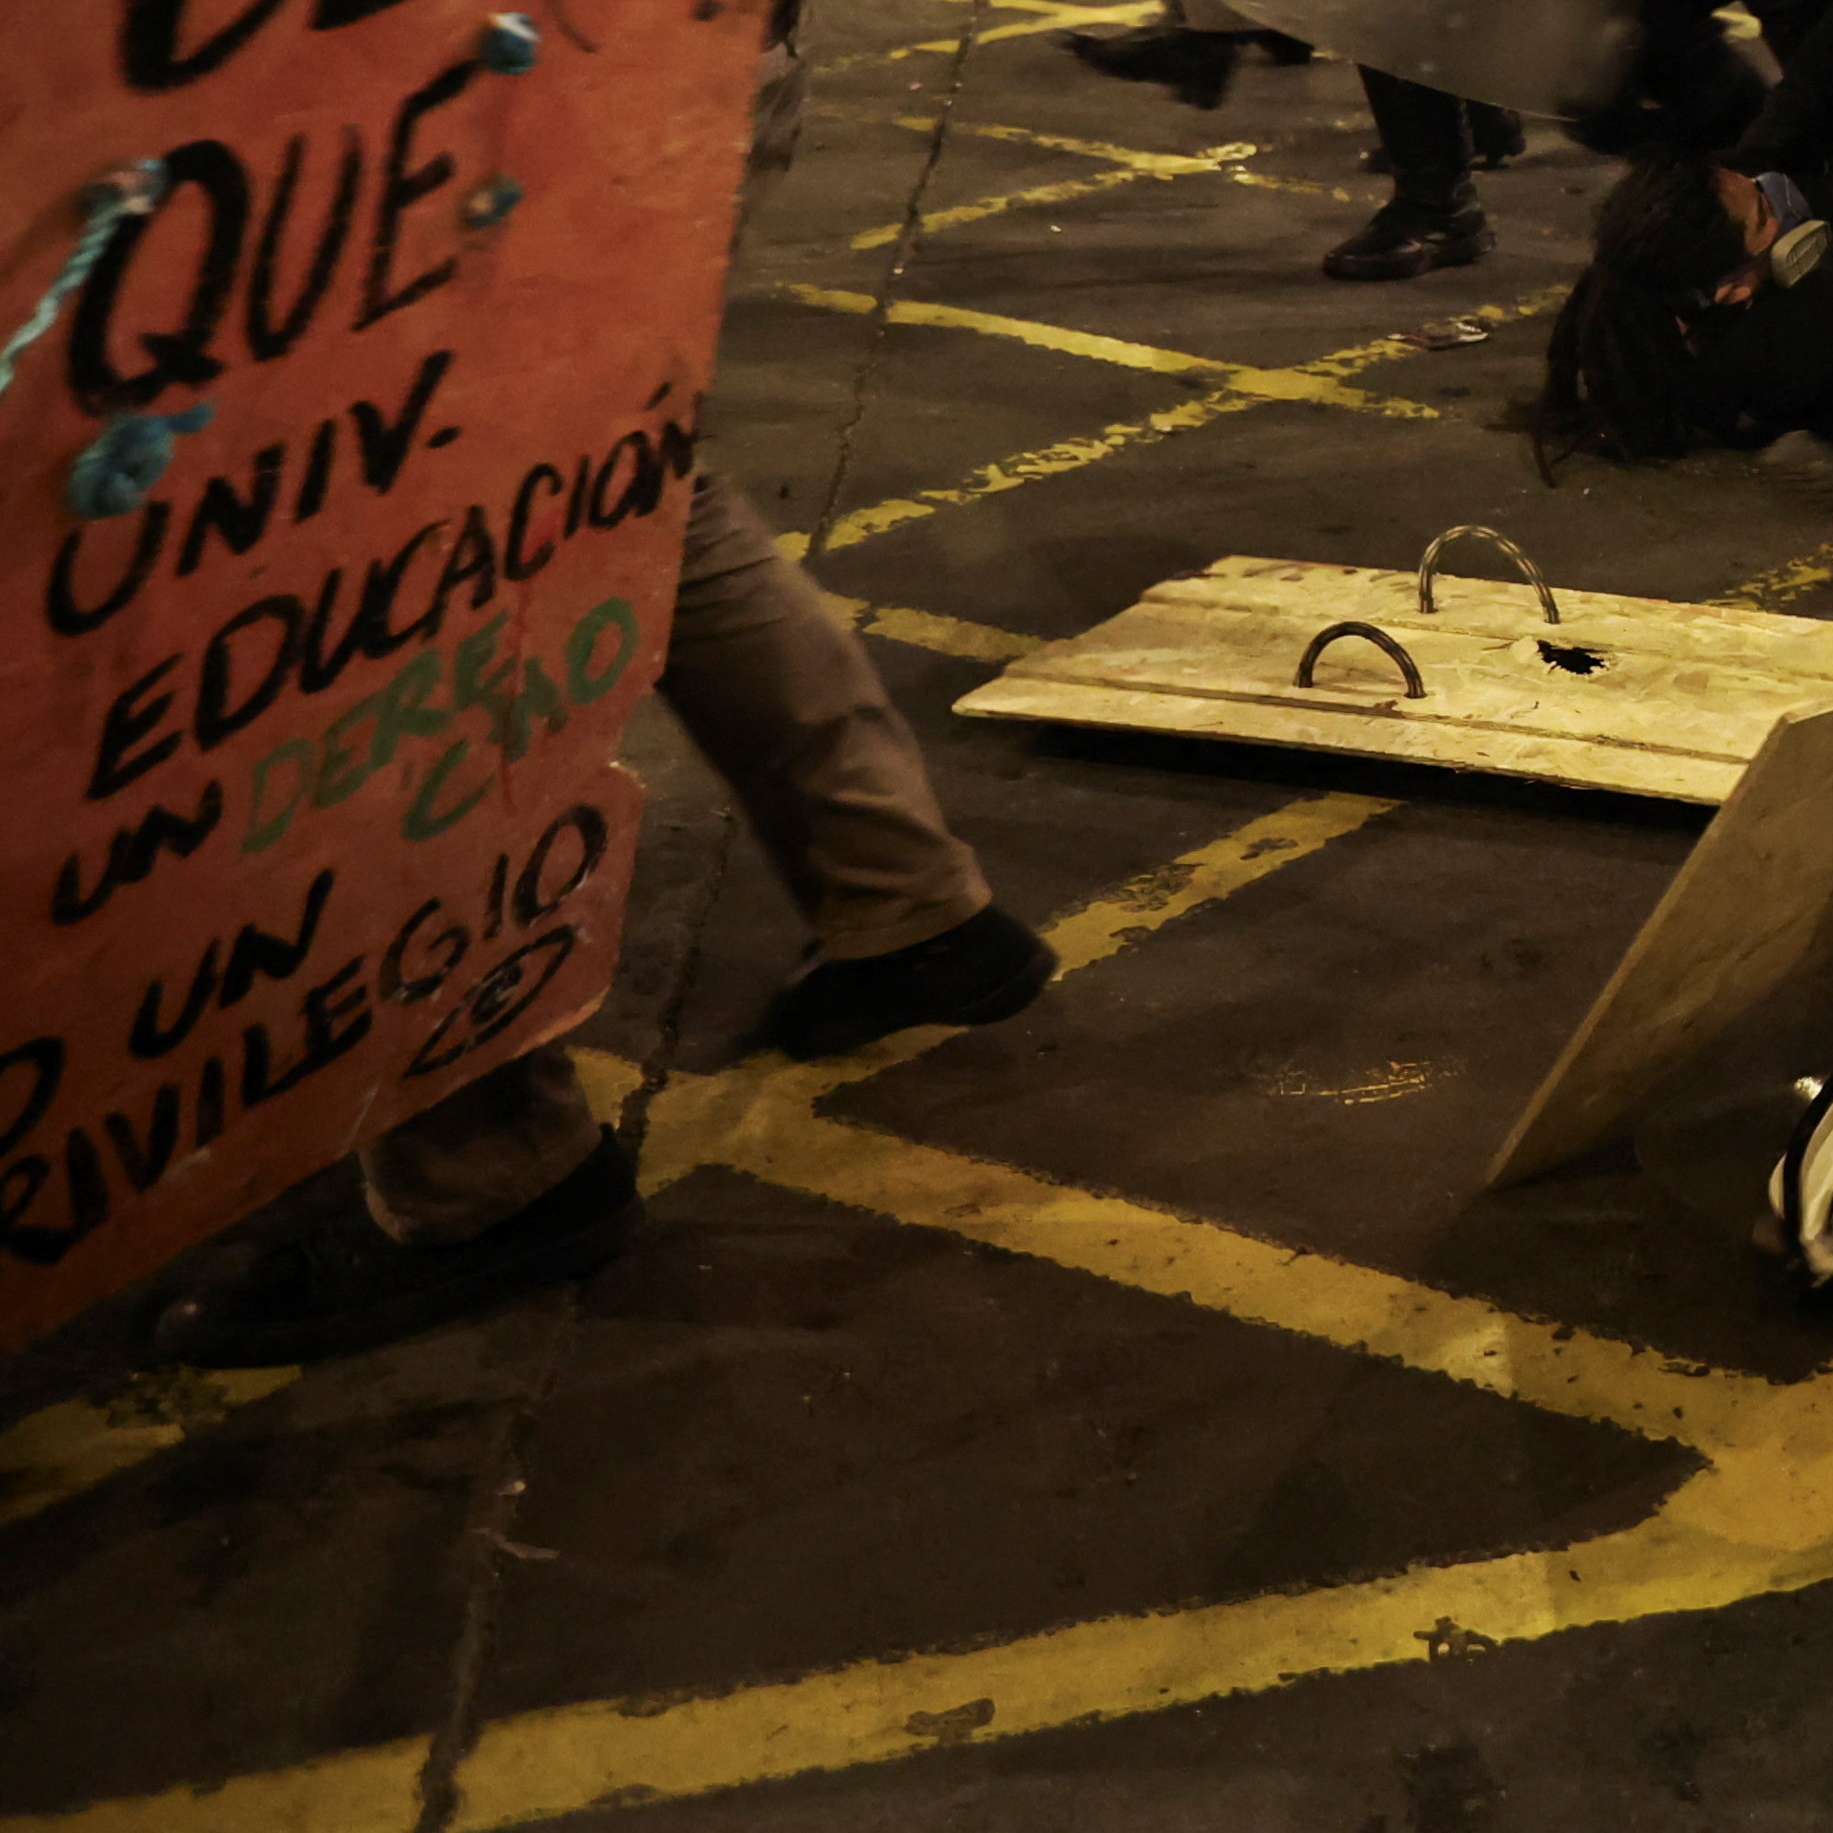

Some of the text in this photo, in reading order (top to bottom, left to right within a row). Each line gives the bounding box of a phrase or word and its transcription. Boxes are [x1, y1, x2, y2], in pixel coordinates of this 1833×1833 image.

[69, 59, 482, 418] QUE
[47, 350, 462, 636] UNIV.
[87, 382, 700, 799] EDUCACIÓN
[129, 868, 333, 1057] UN
